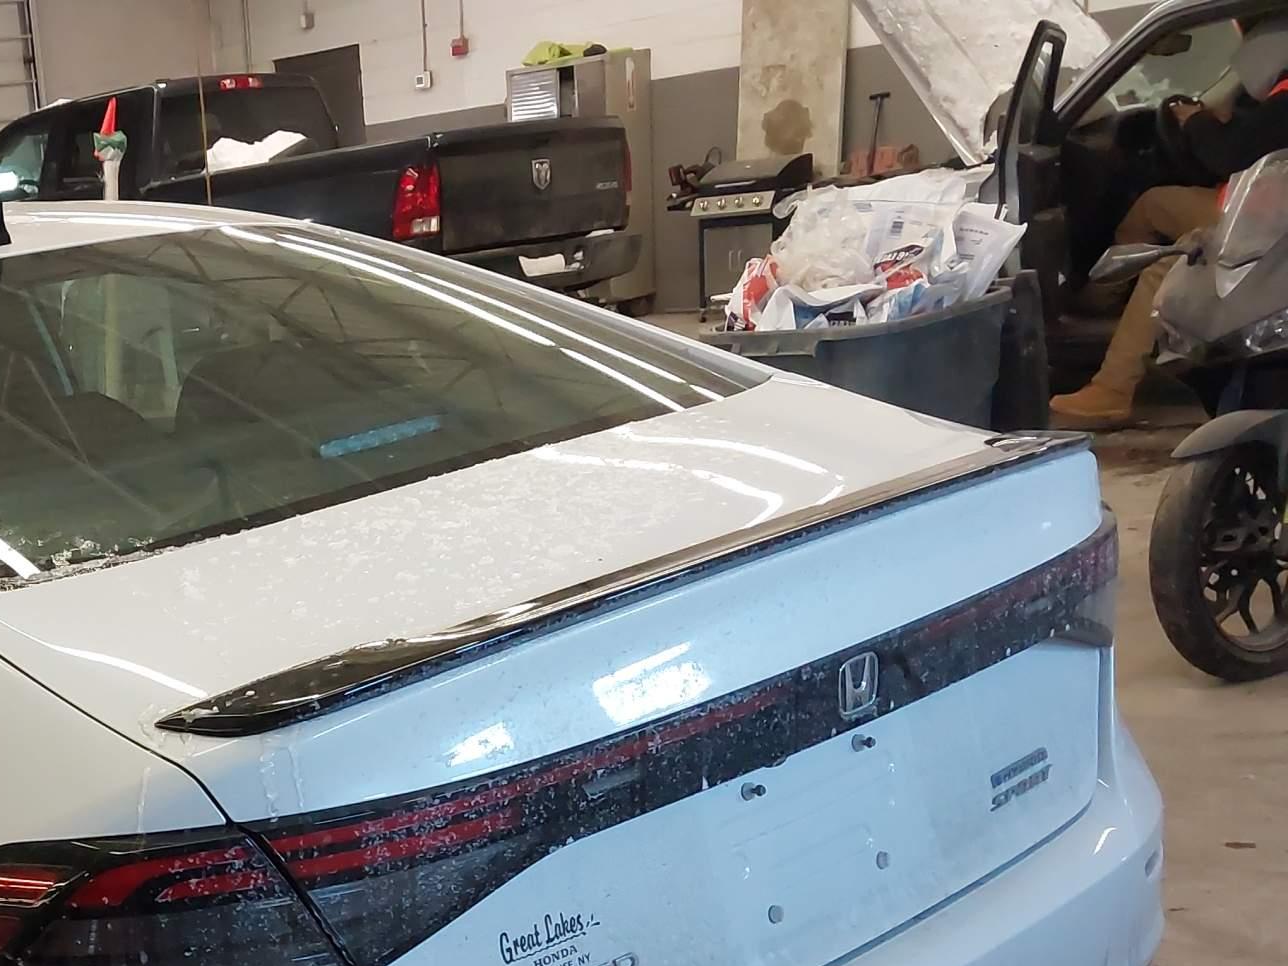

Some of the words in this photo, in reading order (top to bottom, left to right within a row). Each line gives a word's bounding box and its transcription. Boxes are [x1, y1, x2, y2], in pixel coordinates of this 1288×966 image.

[499, 923, 543, 965] Great
[544, 912, 584, 944] Lakes
[577, 952, 592, 966] NY
